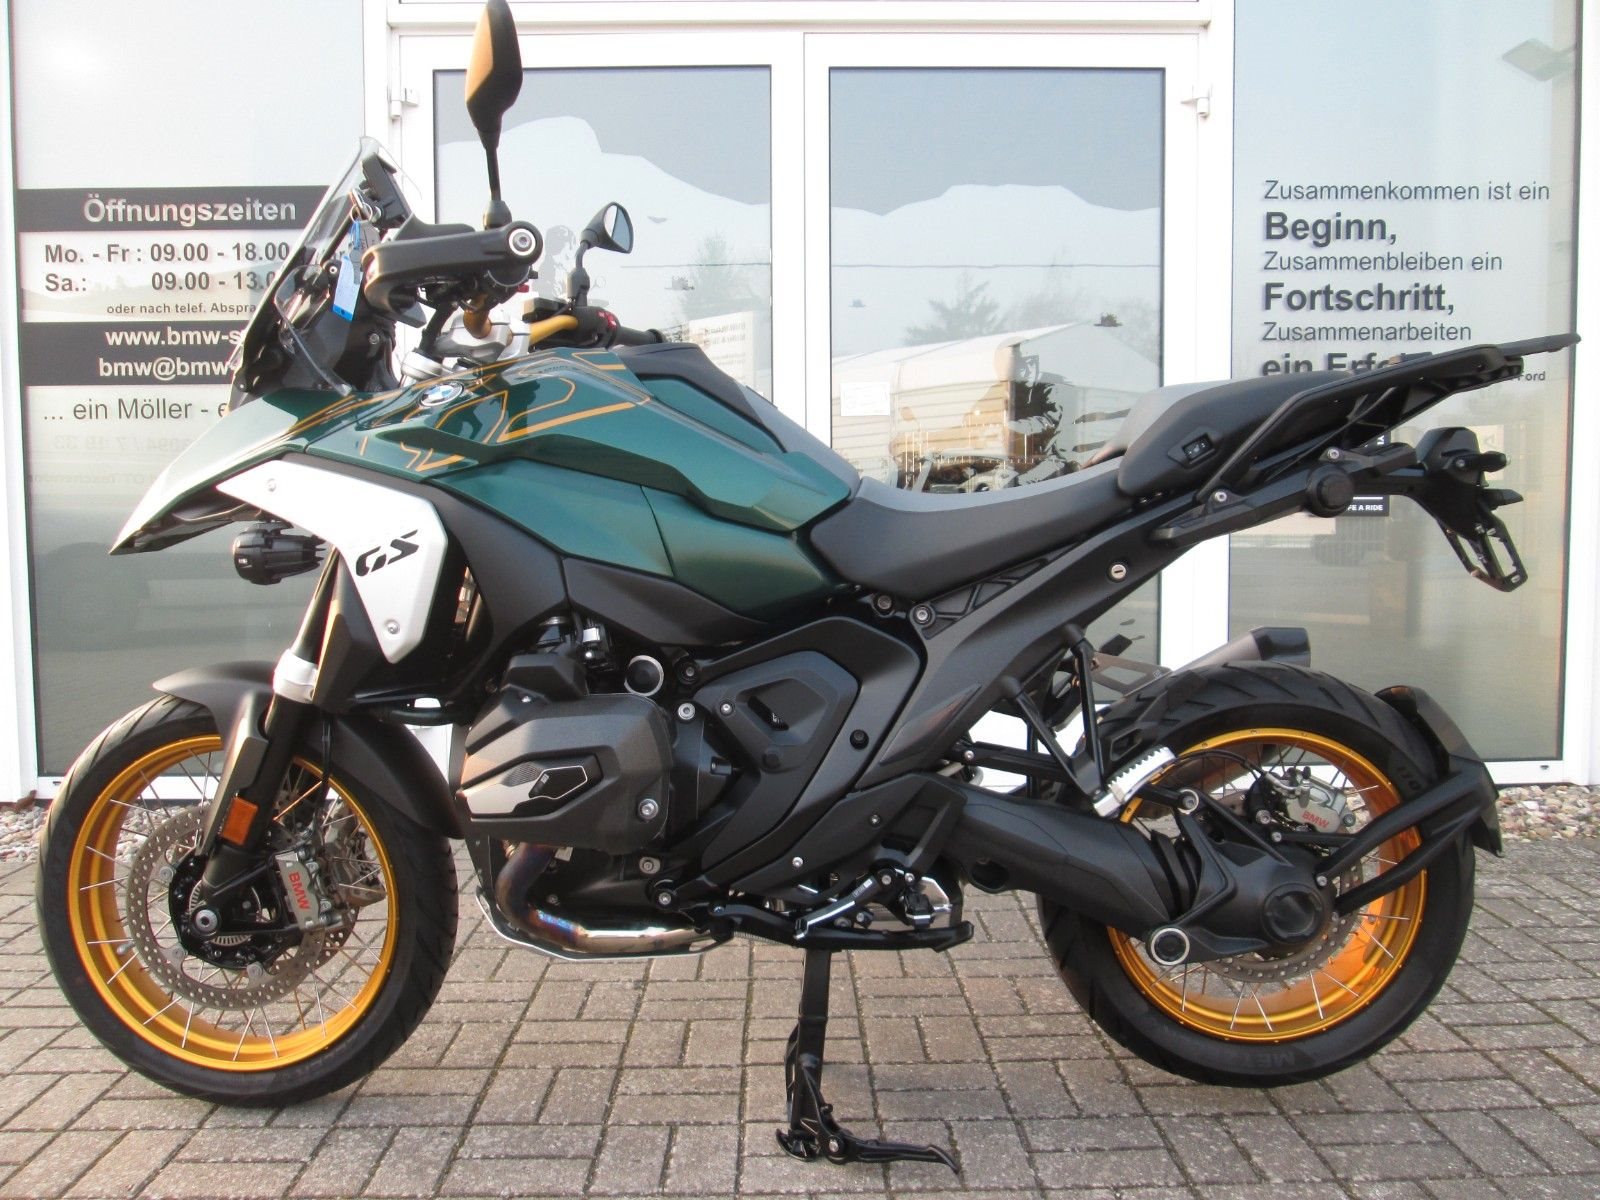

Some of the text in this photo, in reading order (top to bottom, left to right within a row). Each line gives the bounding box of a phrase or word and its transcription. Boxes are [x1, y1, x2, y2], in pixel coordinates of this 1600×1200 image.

[1264, 179, 1551, 201] Zusammenkommen ist ein
[83, 193, 297, 228] Öffnungszeiten
[1264, 211, 1398, 248] Beginn,
[45, 243, 85, 263] Mo.
[150, 242, 209, 262] 09.00
[233, 241, 290, 261] 18.00
[1263, 250, 1503, 271] Zusammenbleiben ein
[45, 273, 87, 292] Sa.:
[151, 271, 210, 290] 09.00
[106, 303, 135, 315] oder
[139, 302, 171, 314] nach
[173, 302, 207, 314] telef.
[1263, 281, 1455, 315] Fortschritt,
[1262, 321, 1472, 342] Zusammenarbeiten
[1262, 351, 1389, 376] ein Erf
[72, 399, 108, 420] ein
[118, 398, 193, 420] Möller
[355, 529, 420, 577] GS
[1302, 810, 1330, 828] BMW
[288, 872, 310, 909] BMW
